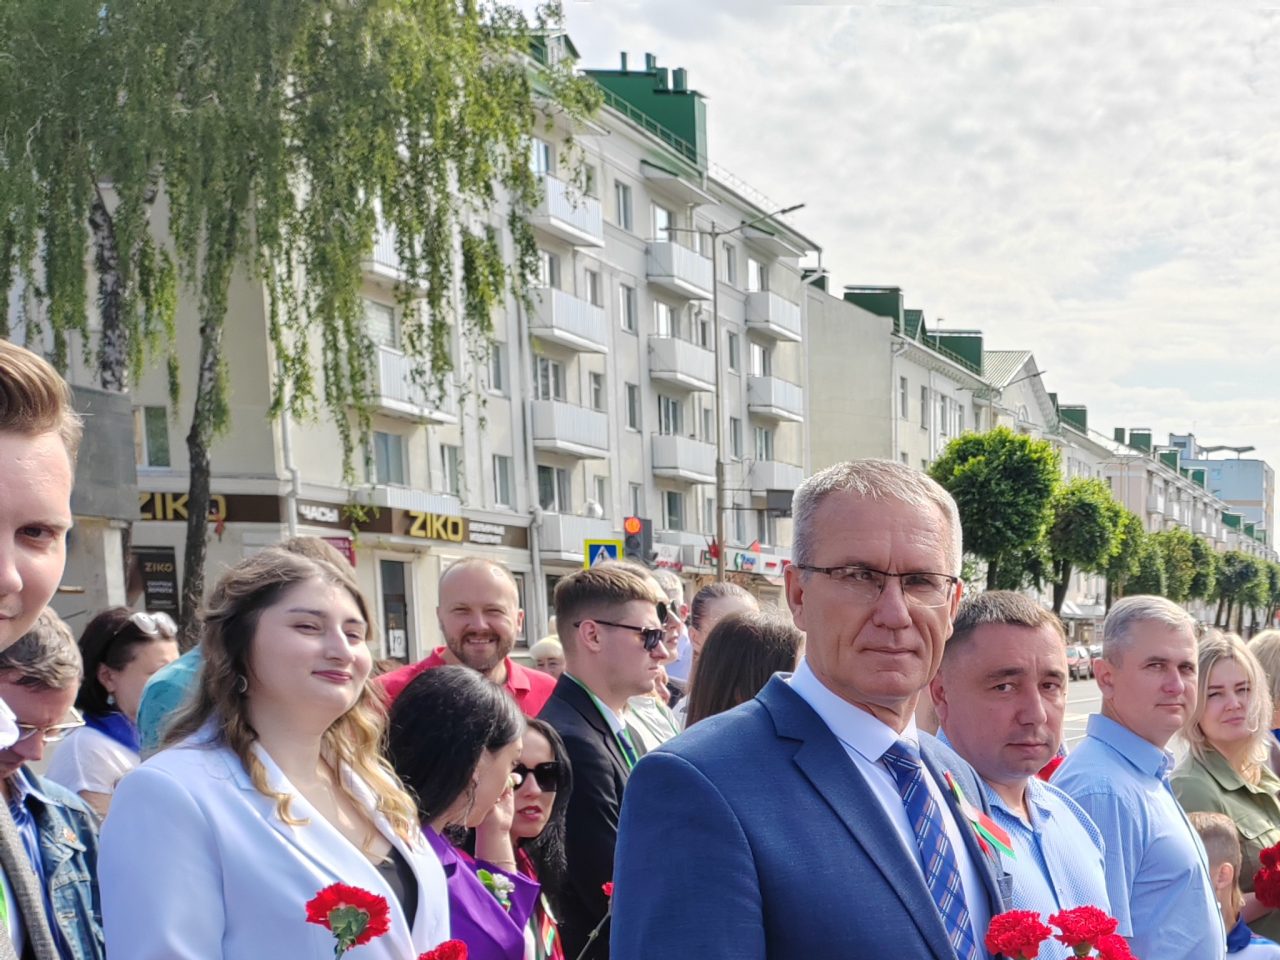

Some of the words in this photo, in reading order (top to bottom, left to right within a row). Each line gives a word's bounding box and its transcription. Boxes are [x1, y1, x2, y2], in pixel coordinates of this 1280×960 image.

[138, 492, 227, 521] ZIKO
[408, 511, 463, 542] ZIKO
[144, 562, 174, 573] ZIKO
